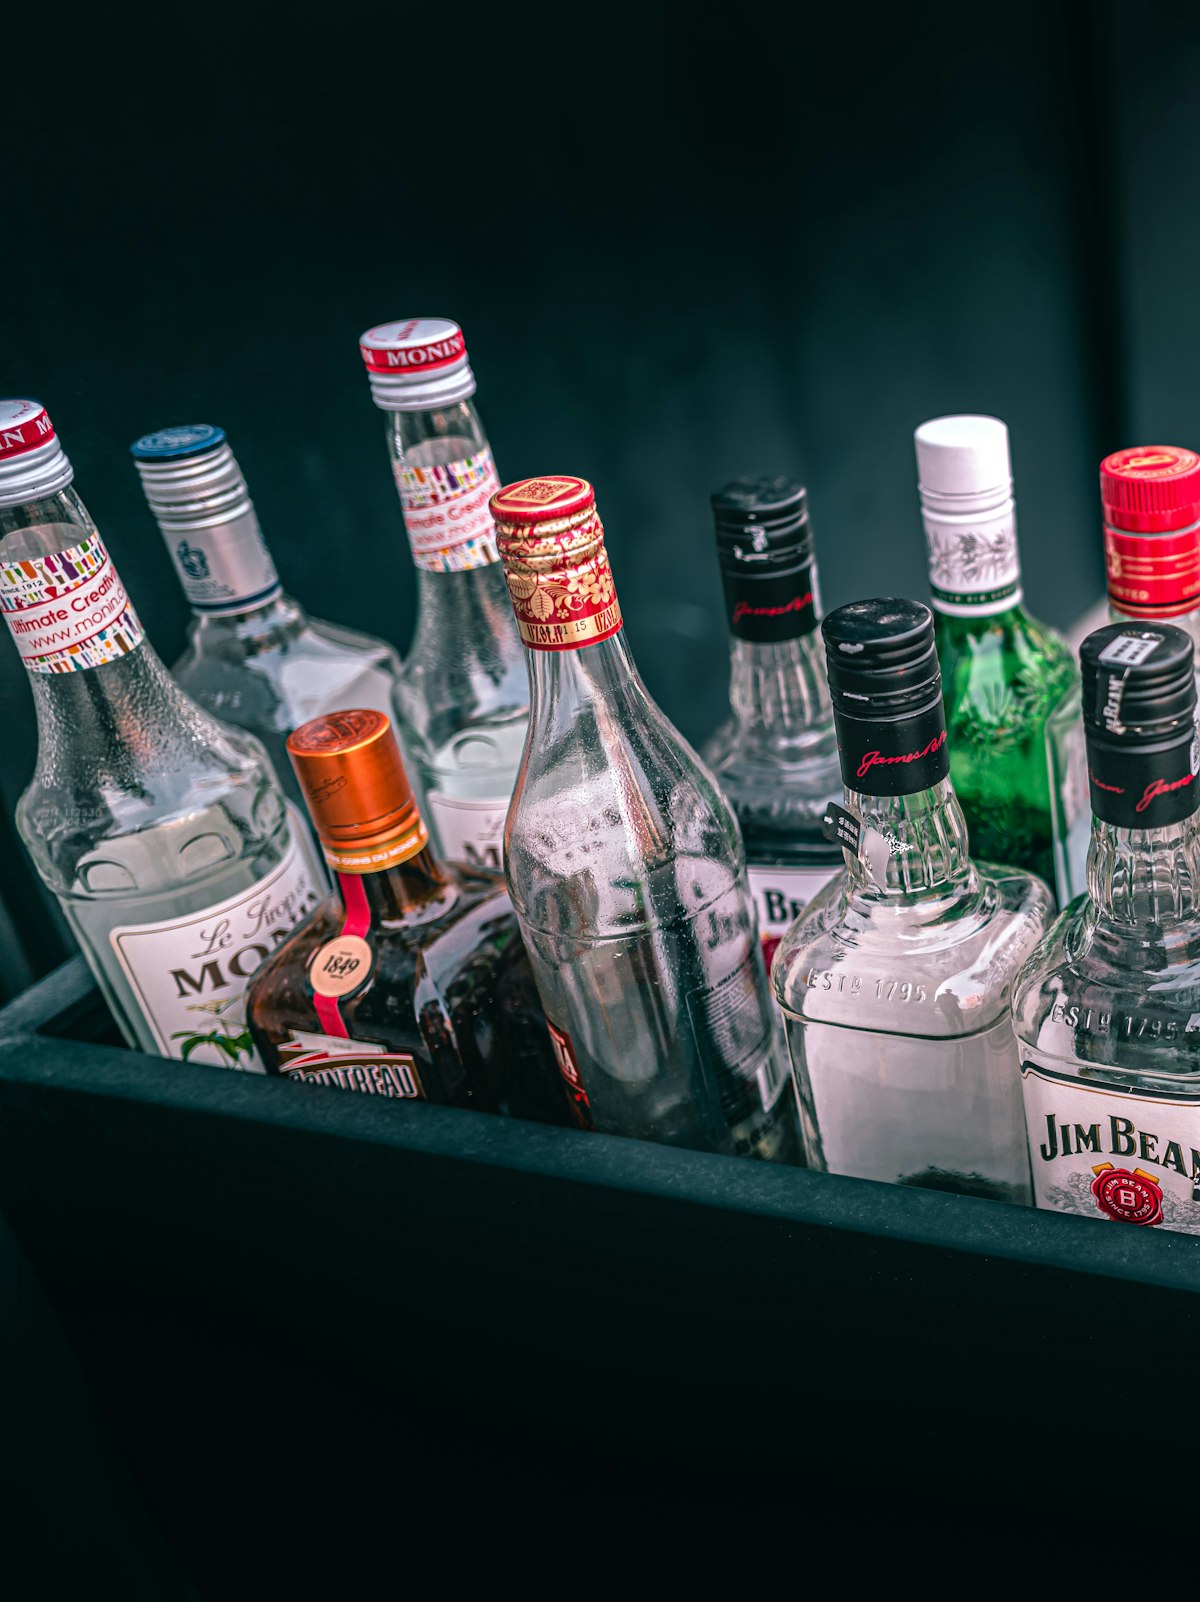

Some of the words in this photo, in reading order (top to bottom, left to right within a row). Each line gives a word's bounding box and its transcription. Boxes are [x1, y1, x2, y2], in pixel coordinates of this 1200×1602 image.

[386, 335, 461, 367] MONIN
[22, 580, 44, 591] 1912
[10, 609, 69, 634] Ultimate
[191, 918, 235, 959] Le
[323, 955, 360, 976] 1849
[875, 978, 927, 1003] 1795
[1040, 1113, 1103, 1161] JIM
[1107, 1179, 1118, 1190] JIM
[1121, 1178, 1149, 1198] BEAM
[1120, 1189, 1136, 1208] B
[1105, 1195, 1131, 1218] SINCE
[1133, 1203, 1151, 1218] 1795
